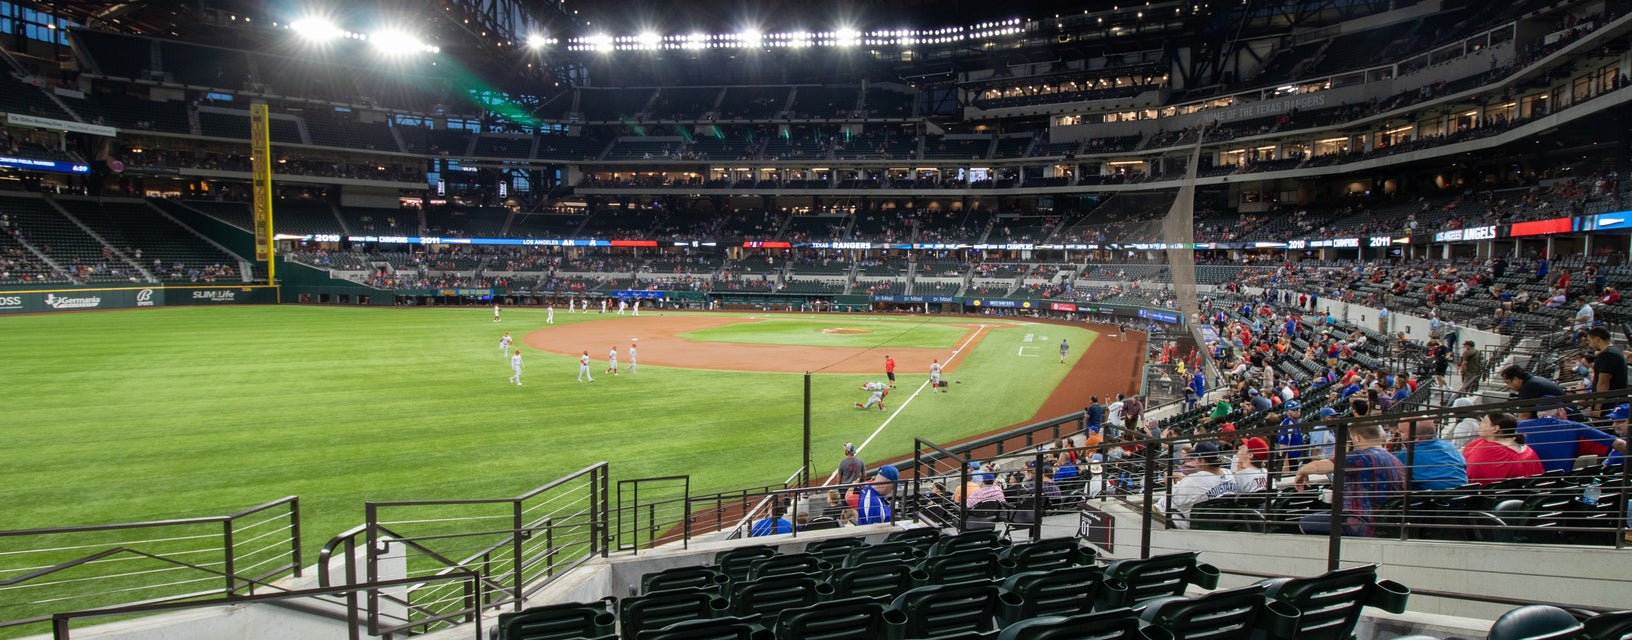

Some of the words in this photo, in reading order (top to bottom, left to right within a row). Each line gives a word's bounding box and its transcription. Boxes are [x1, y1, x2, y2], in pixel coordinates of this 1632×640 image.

[1203, 111, 1225, 122] HOME
[1227, 109, 1238, 117] OF
[1240, 106, 1255, 116] THE
[1256, 102, 1282, 114] TEXAS
[1284, 94, 1325, 111] RANGERS
[314, 234, 340, 242] 2010
[1463, 225, 1497, 240] ANGELS
[1288, 240, 1305, 248] 2010
[1369, 236, 1391, 247] 2011
[62, 295, 100, 304] Germania
[1205, 481, 1237, 498] MOUSTAKA
[1081, 520, 1090, 537] 01
